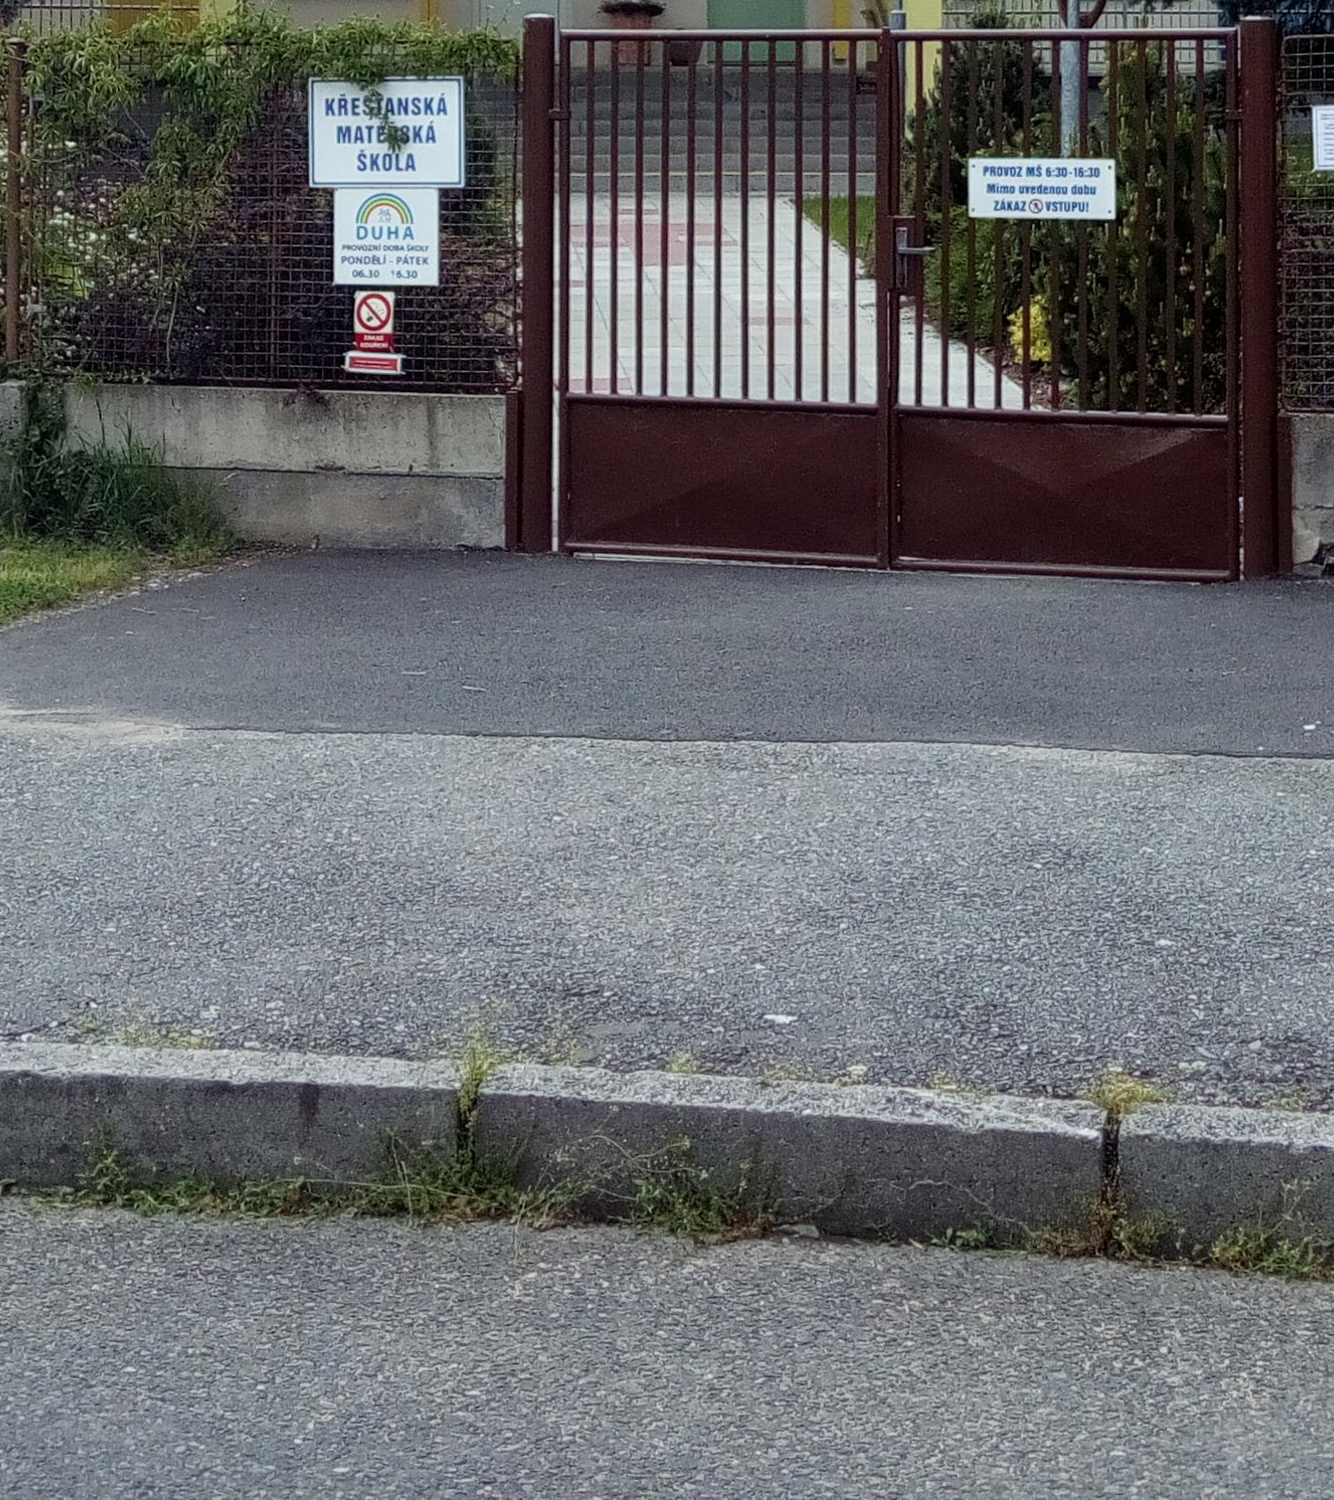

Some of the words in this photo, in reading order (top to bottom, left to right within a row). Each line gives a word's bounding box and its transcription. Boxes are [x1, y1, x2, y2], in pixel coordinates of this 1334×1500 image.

[357, 149, 416, 172] ŠKOLA
[983, 166, 1023, 177] PROVOZ
[1026, 164, 1042, 177] MŠ
[986, 183, 1015, 194] Mimo
[1019, 183, 1067, 195] uvedenou
[1071, 184, 1097, 195] dobu
[993, 198, 1026, 212] ZÁKAZ
[1045, 202, 1089, 213] VSTUPU!
[356, 226, 414, 240] DUHA
[341, 254, 387, 265] PONDĚLÍ
[396, 254, 429, 265] PÁTEK
[352, 269, 380, 278] 06.30
